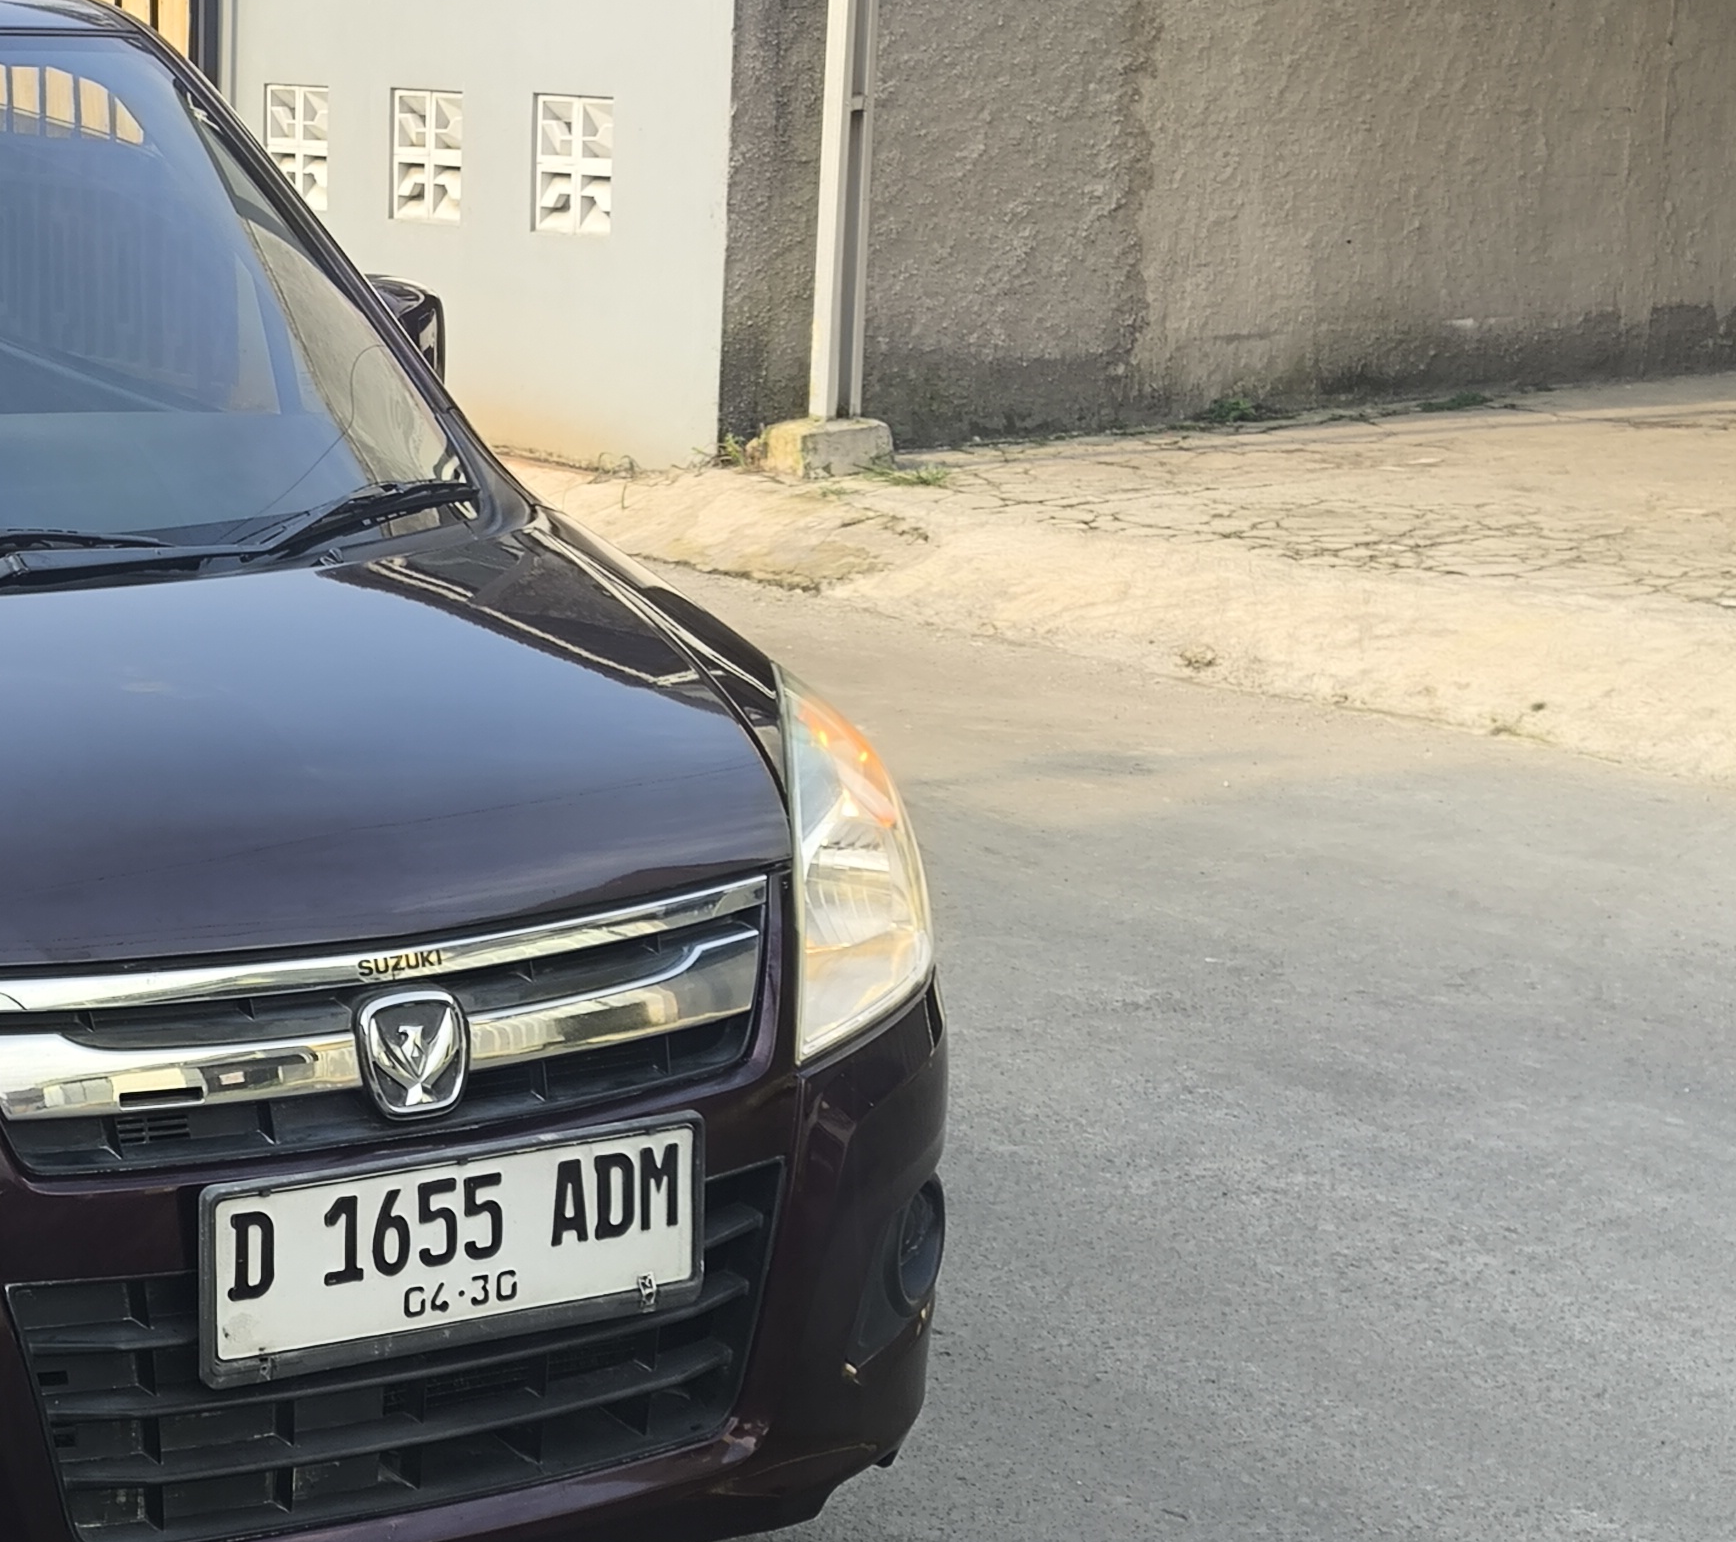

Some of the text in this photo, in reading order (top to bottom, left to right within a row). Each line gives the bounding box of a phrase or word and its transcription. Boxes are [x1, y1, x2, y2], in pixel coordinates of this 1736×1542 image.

[357, 949, 443, 977] SUZUKI
[227, 1142, 680, 1302] D 1655 ADM
